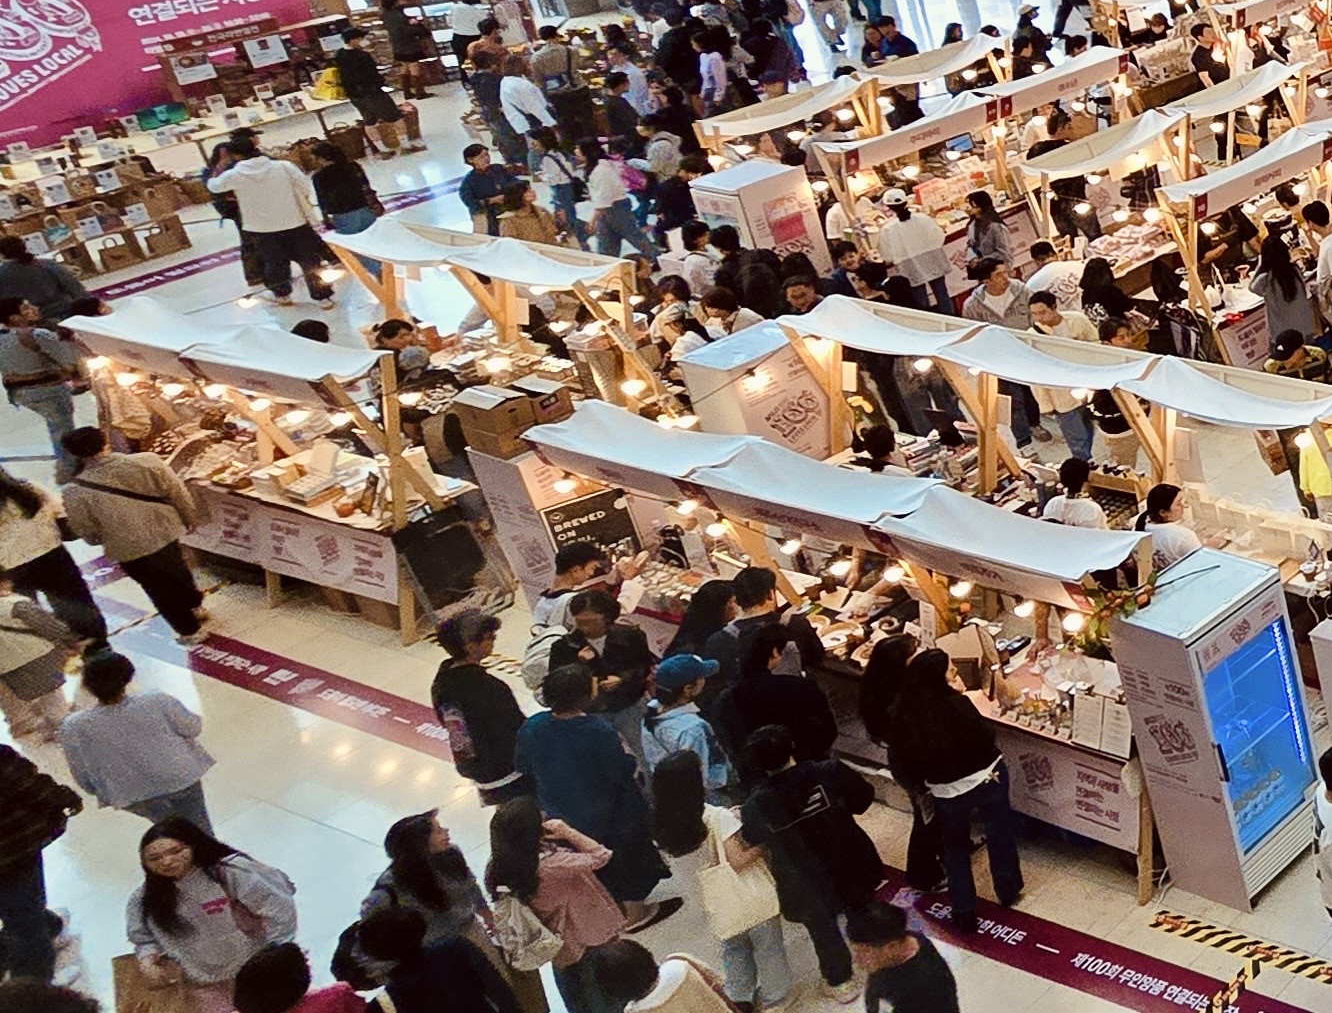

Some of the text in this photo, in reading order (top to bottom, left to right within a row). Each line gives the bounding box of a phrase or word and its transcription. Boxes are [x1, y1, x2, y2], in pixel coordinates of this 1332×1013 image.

[33, 43, 85, 78] LOCAL
[553, 510, 606, 533] BREWED
[557, 530, 577, 541] ON
[1070, 952, 1121, 980] 제100회
